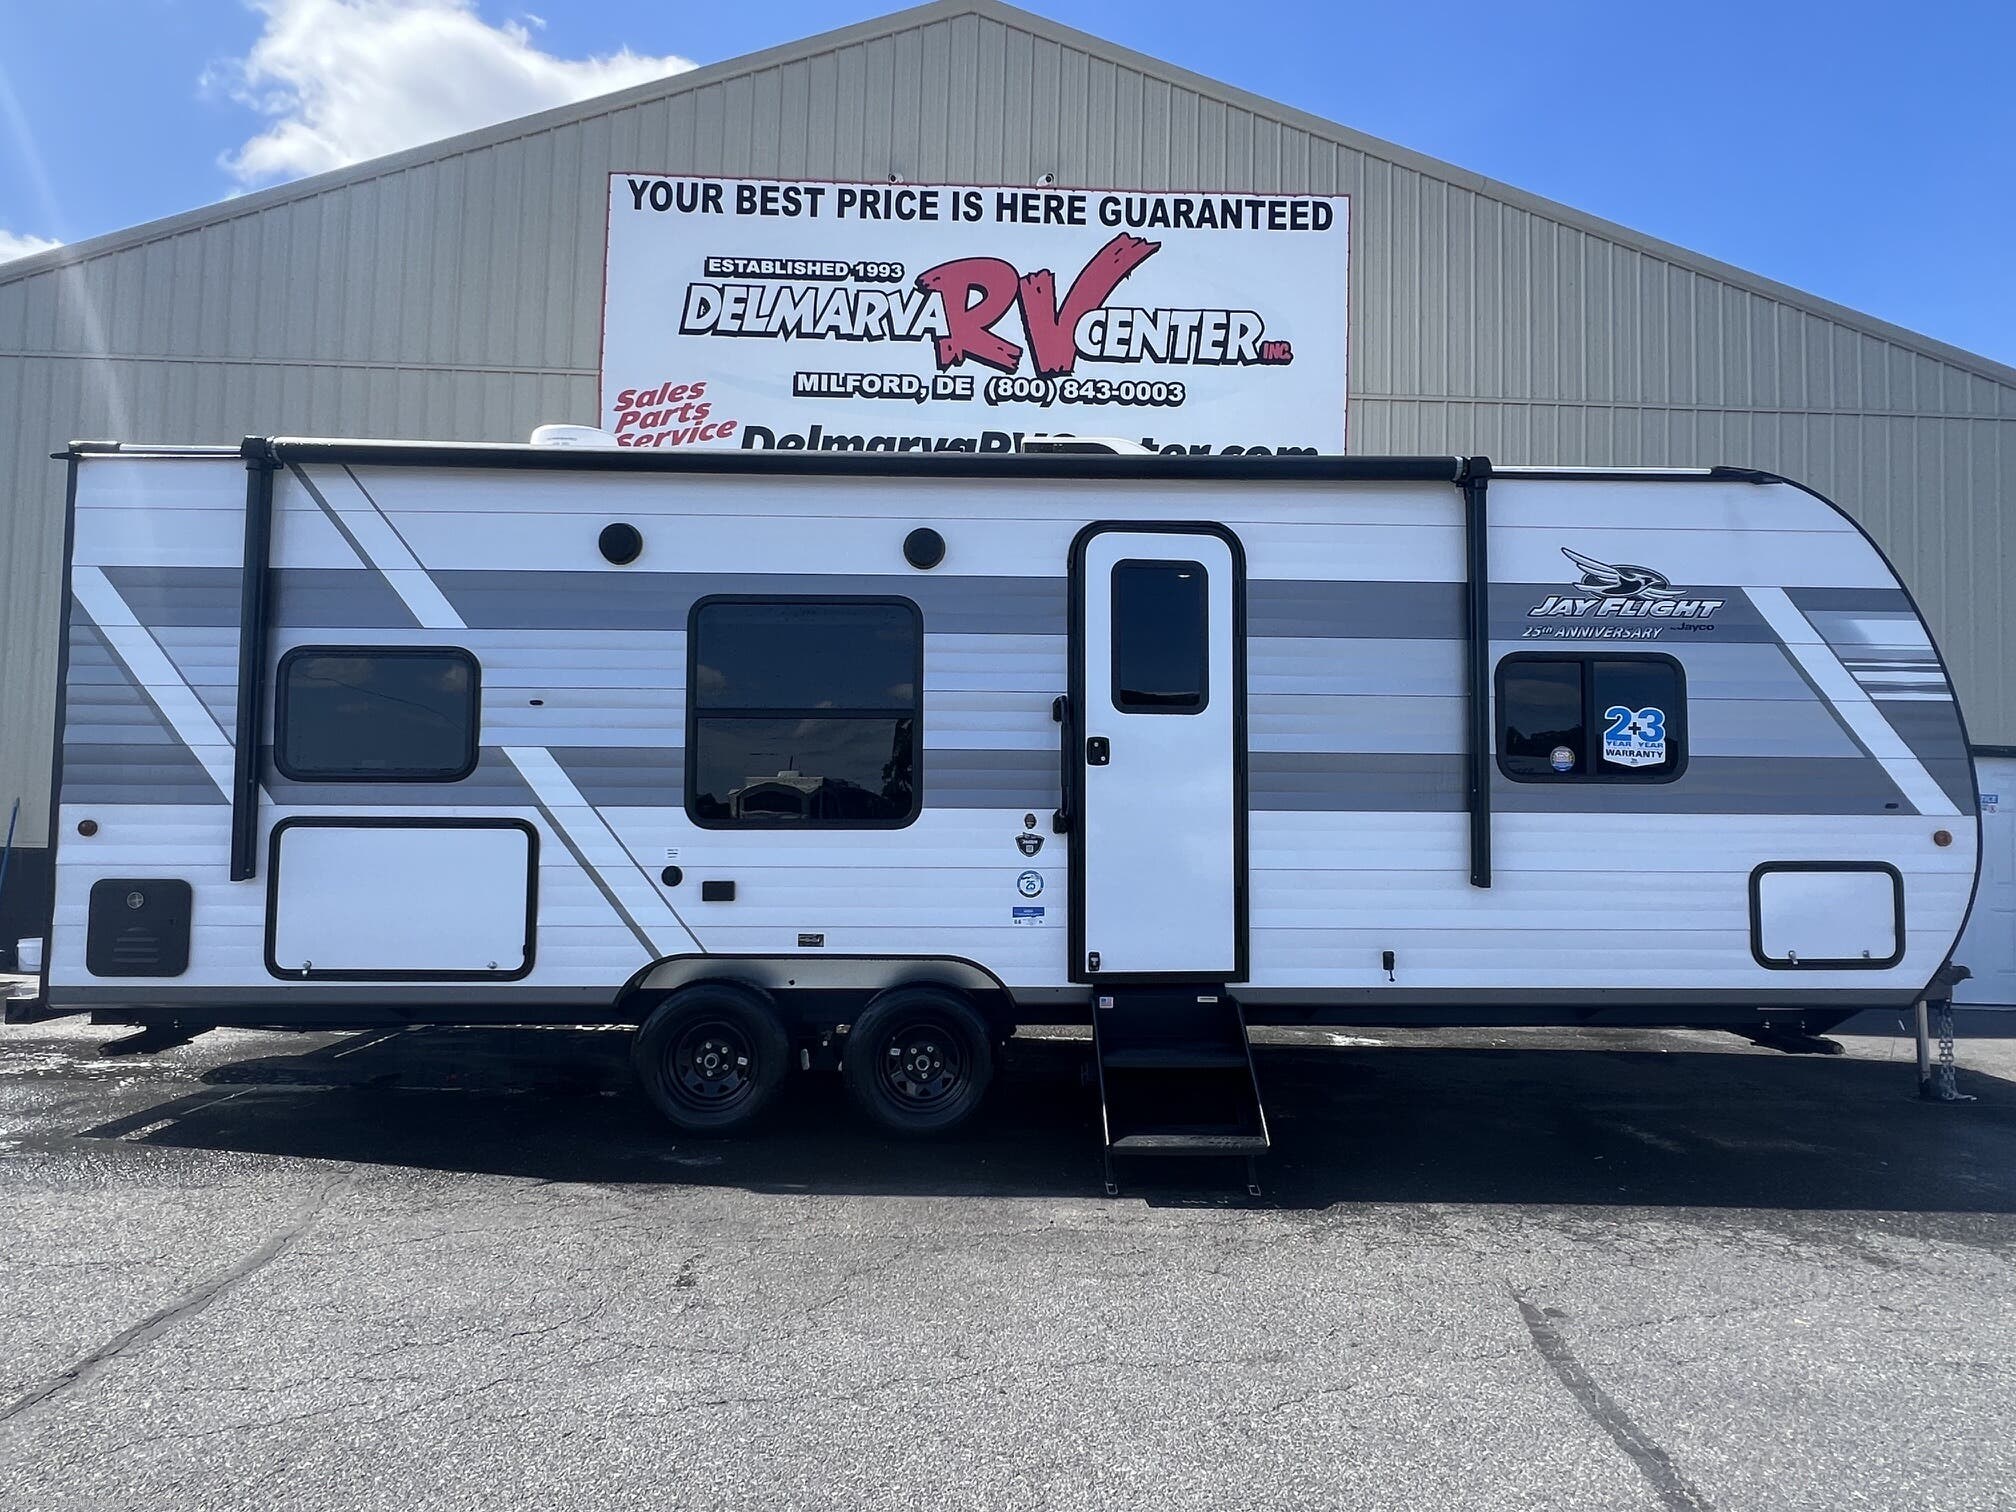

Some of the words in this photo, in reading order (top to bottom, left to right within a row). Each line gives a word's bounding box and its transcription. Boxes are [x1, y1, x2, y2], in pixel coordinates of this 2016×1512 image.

[627, 179, 724, 215] YOUR
[736, 184, 825, 219] BEST
[837, 187, 939, 221] PRICE
[951, 190, 984, 222] IS
[996, 191, 1087, 226] HERE
[1100, 195, 1334, 231] GUARANTEED
[705, 257, 851, 279] ESTABLISHED
[854, 263, 905, 282] 1993
[679, 283, 950, 341] DELMARVA
[914, 232, 1162, 378] RV
[1074, 308, 1265, 365] CENTER
[613, 381, 707, 412] Sales
[793, 371, 929, 404] MILFORD,
[933, 375, 974, 401] DE
[985, 376, 1056, 407] (800)
[1063, 380, 1186, 407] 843-0003
[614, 402, 712, 434] Parts
[616, 420, 738, 447] Service
[1527, 596, 1598, 618] JAY
[1596, 597, 1724, 619] FLIGHT
[1554, 625, 1664, 640] ANNIVERSARY
[1677, 622, 1715, 632] Jayco
[1605, 748, 1664, 758] WARRANTY
